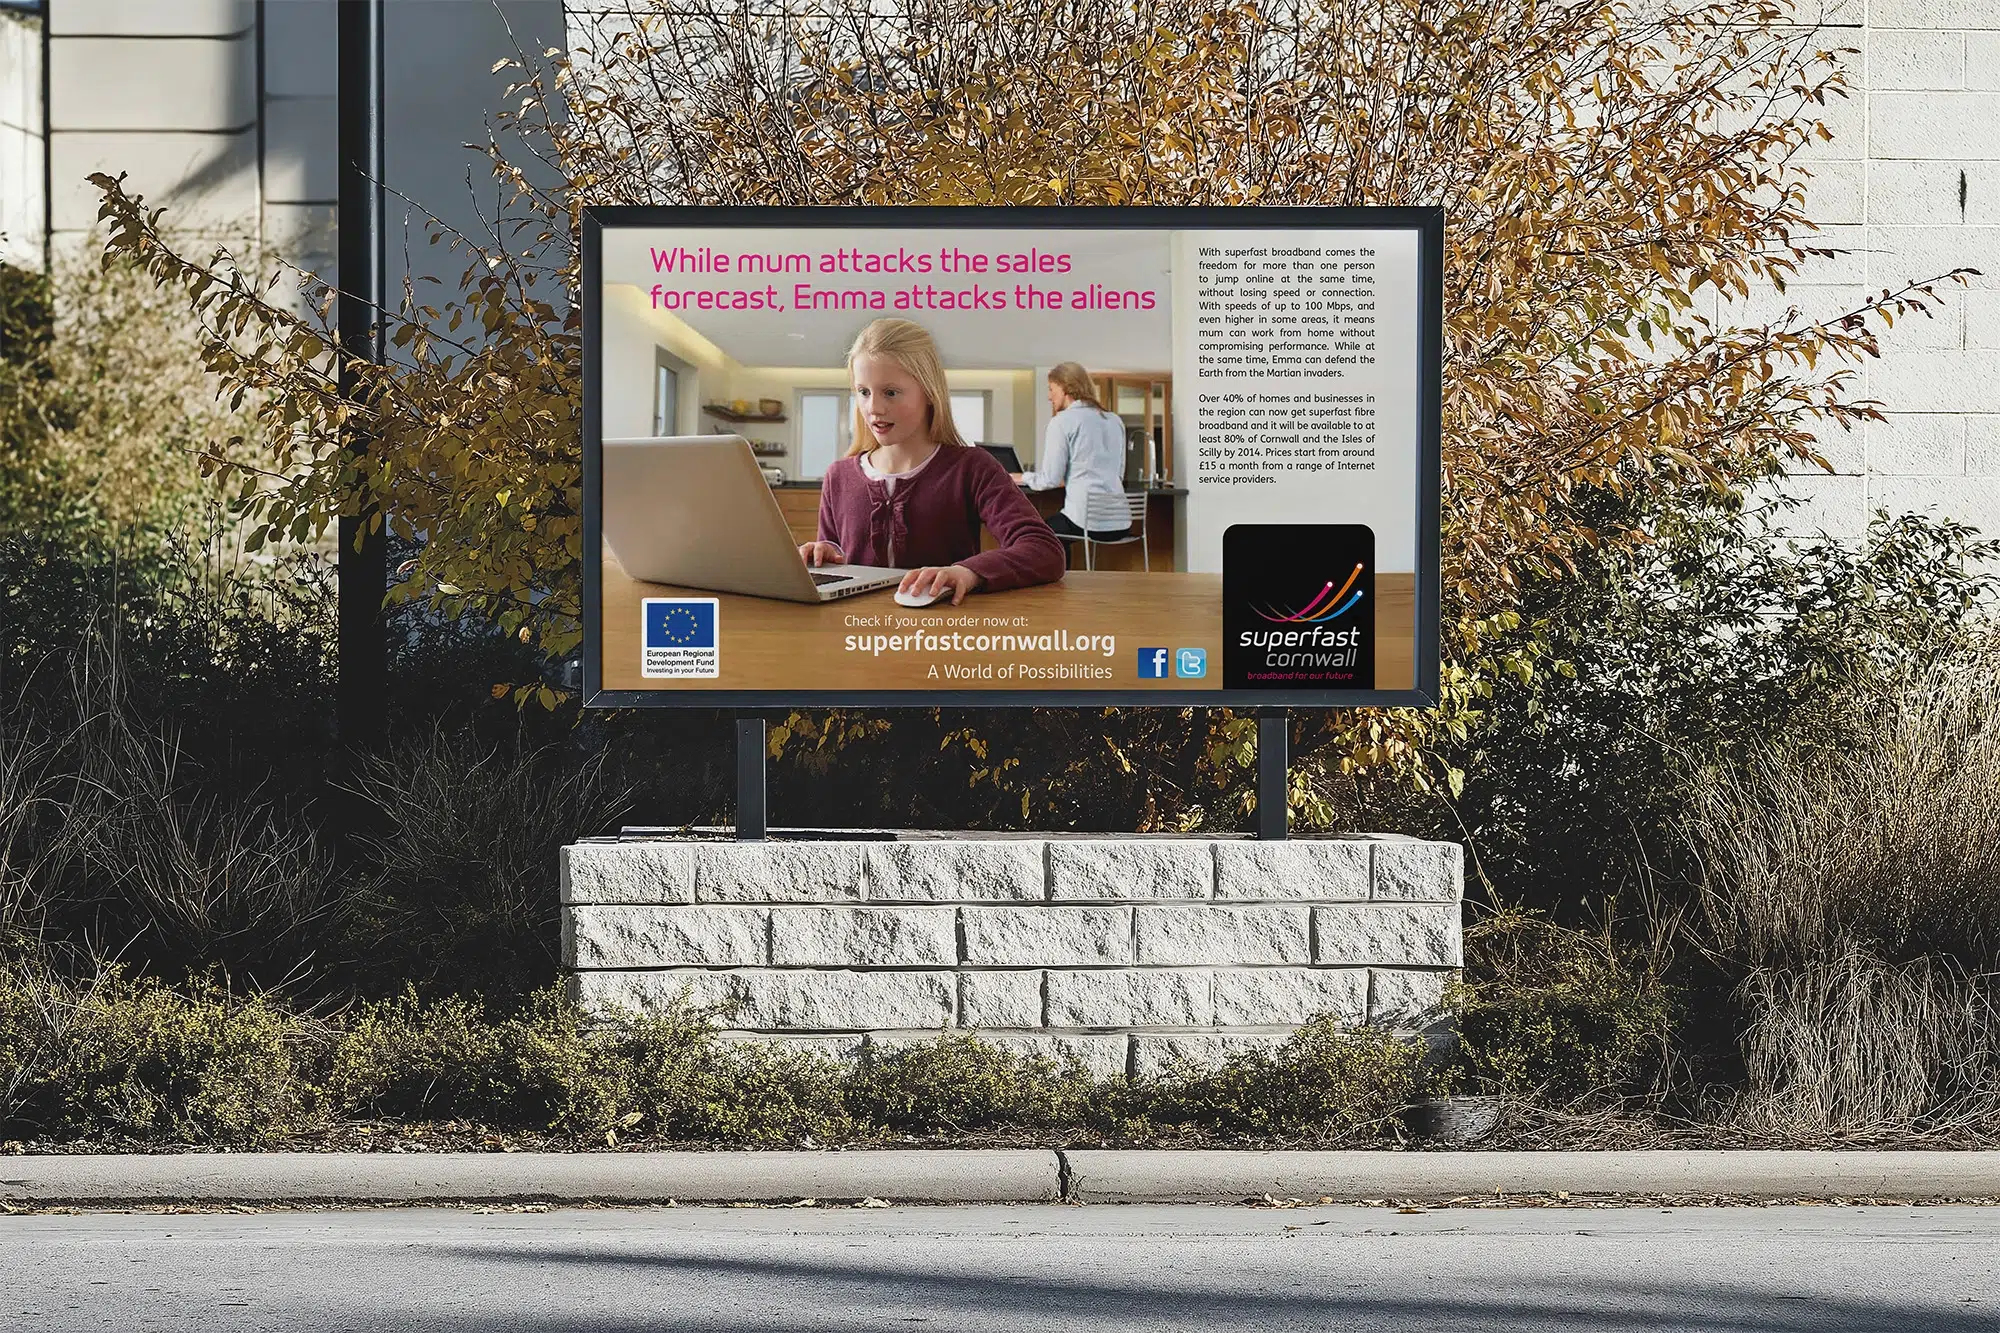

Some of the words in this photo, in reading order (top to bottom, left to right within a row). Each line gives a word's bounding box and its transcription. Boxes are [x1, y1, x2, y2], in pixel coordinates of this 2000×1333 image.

[1199, 247, 1221, 256] With
[1225, 247, 1267, 258] superfast
[1272, 247, 1321, 256] broadband
[1360, 247, 1375, 256] the
[650, 248, 730, 273] While
[738, 254, 811, 273] mum
[819, 248, 932, 273] attacks
[940, 248, 989, 273] the
[996, 248, 1071, 273] sales
[1199, 261, 1237, 270] freedom
[1244, 261, 1256, 270] for
[1293, 261, 1314, 270] than
[1344, 263, 1375, 272] person
[1199, 275, 1209, 283] to
[1214, 274, 1239, 285] jump
[1246, 274, 1274, 283] online
[1281, 275, 1290, 283] at
[1297, 274, 1313, 283] the
[1352, 274, 1375, 284] time,
[650, 284, 784, 312] forecast,
[794, 283, 885, 310] Emma
[894, 284, 1007, 310] attacks
[1014, 284, 1063, 310] the
[1071, 284, 1155, 310] aliens
[1198, 288, 1234, 297] without
[1240, 288, 1267, 299] losing
[1273, 288, 1300, 299] speed
[1322, 288, 1375, 297] connection.
[1199, 301, 1221, 310] With
[1225, 301, 1257, 312] speeds
[1261, 301, 1271, 310] of
[1275, 303, 1287, 312] up
[1291, 302, 1301, 310] to
[1305, 301, 1323, 310] 100
[1327, 301, 1353, 312] Mbps,
[1357, 301, 1375, 310] and
[1225, 315, 1254, 326] higher
[1259, 315, 1267, 323] in
[1301, 317, 1329, 325] areas,
[1333, 315, 1340, 324] it
[1251, 328, 1274, 337] work
[1280, 328, 1302, 337] from
[1307, 328, 1334, 337] home
[1340, 328, 1375, 337] without
[1199, 342, 1263, 353] compromising
[1269, 342, 1329, 352] performance.
[1334, 342, 1360, 350] While
[1365, 342, 1375, 350] at
[1199, 355, 1214, 364] the
[1245, 355, 1269, 365] time,
[1272, 355, 1302, 364] Emma
[1325, 355, 1356, 364] defend
[1360, 355, 1375, 364] the
[1199, 369, 1223, 377] Earth
[1225, 369, 1247, 377] from
[1249, 369, 1264, 377] the
[1267, 369, 1301, 377] Martian
[1304, 369, 1344, 377] invaders.
[1199, 394, 1220, 403] Over
[1223, 394, 1244, 403] 40%
[1247, 394, 1257, 403] of
[1259, 394, 1290, 403] homes
[1293, 394, 1311, 403] and
[1314, 394, 1363, 403] businesses
[1366, 394, 1375, 402] in
[1199, 407, 1214, 416] the
[1217, 407, 1246, 418] region
[1291, 408, 1306, 418] get
[1309, 407, 1352, 418] superfast
[1354, 407, 1375, 416] fibre
[1199, 421, 1248, 430] broadband
[1251, 421, 1268, 430] and
[1271, 421, 1277, 430] it
[1279, 421, 1295, 430] will
[1297, 421, 1309, 430] be
[1310, 421, 1351, 430] available
[1353, 422, 1363, 430] to
[1365, 422, 1375, 430] at
[1199, 434, 1221, 443] least
[1224, 434, 1245, 443] 80%
[1248, 434, 1258, 443] of
[1260, 434, 1299, 443] Cornwall
[1302, 434, 1320, 443] and
[1323, 434, 1339, 443] the
[1342, 434, 1363, 443] Isles
[1366, 434, 1376, 443] of
[1199, 448, 1222, 459] Scilly
[1224, 448, 1235, 459] by
[1238, 448, 1263, 457] 2014.
[1265, 448, 1292, 457] Prices
[1294, 448, 1316, 457] start
[1318, 448, 1340, 457] from
[1342, 448, 1375, 457] around
[1199, 461, 1216, 470] £15
[1229, 461, 1259, 470] month
[1262, 461, 1283, 470] from
[1296, 463, 1322, 472] range
[1325, 461, 1335, 470] of
[1338, 461, 1375, 470] Internet
[1199, 474, 1230, 483] service
[1233, 474, 1276, 485] providers.
[845, 615, 880, 626] Check
[885, 615, 892, 626] if
[896, 618, 917, 629] you
[921, 618, 943, 626] can
[947, 616, 979, 626] order
[984, 618, 1009, 626] now
[1013, 616, 1028, 626] at:
[845, 629, 1115, 656] superfastcornwall.org
[1240, 626, 1360, 652] superfast
[647, 650, 681, 658] European
[683, 650, 714, 658] Regional
[1266, 648, 1357, 667] cornwall
[647, 659, 694, 667] Development
[1152, 649, 1167, 677] f
[928, 664, 939, 678] A
[944, 664, 992, 679] World
[998, 664, 1015, 679] of
[1020, 664, 1112, 679] Possibilities
[1247, 671, 1295, 680] broadband
[1295, 671, 1307, 680] for
[1325, 671, 1353, 680] future
